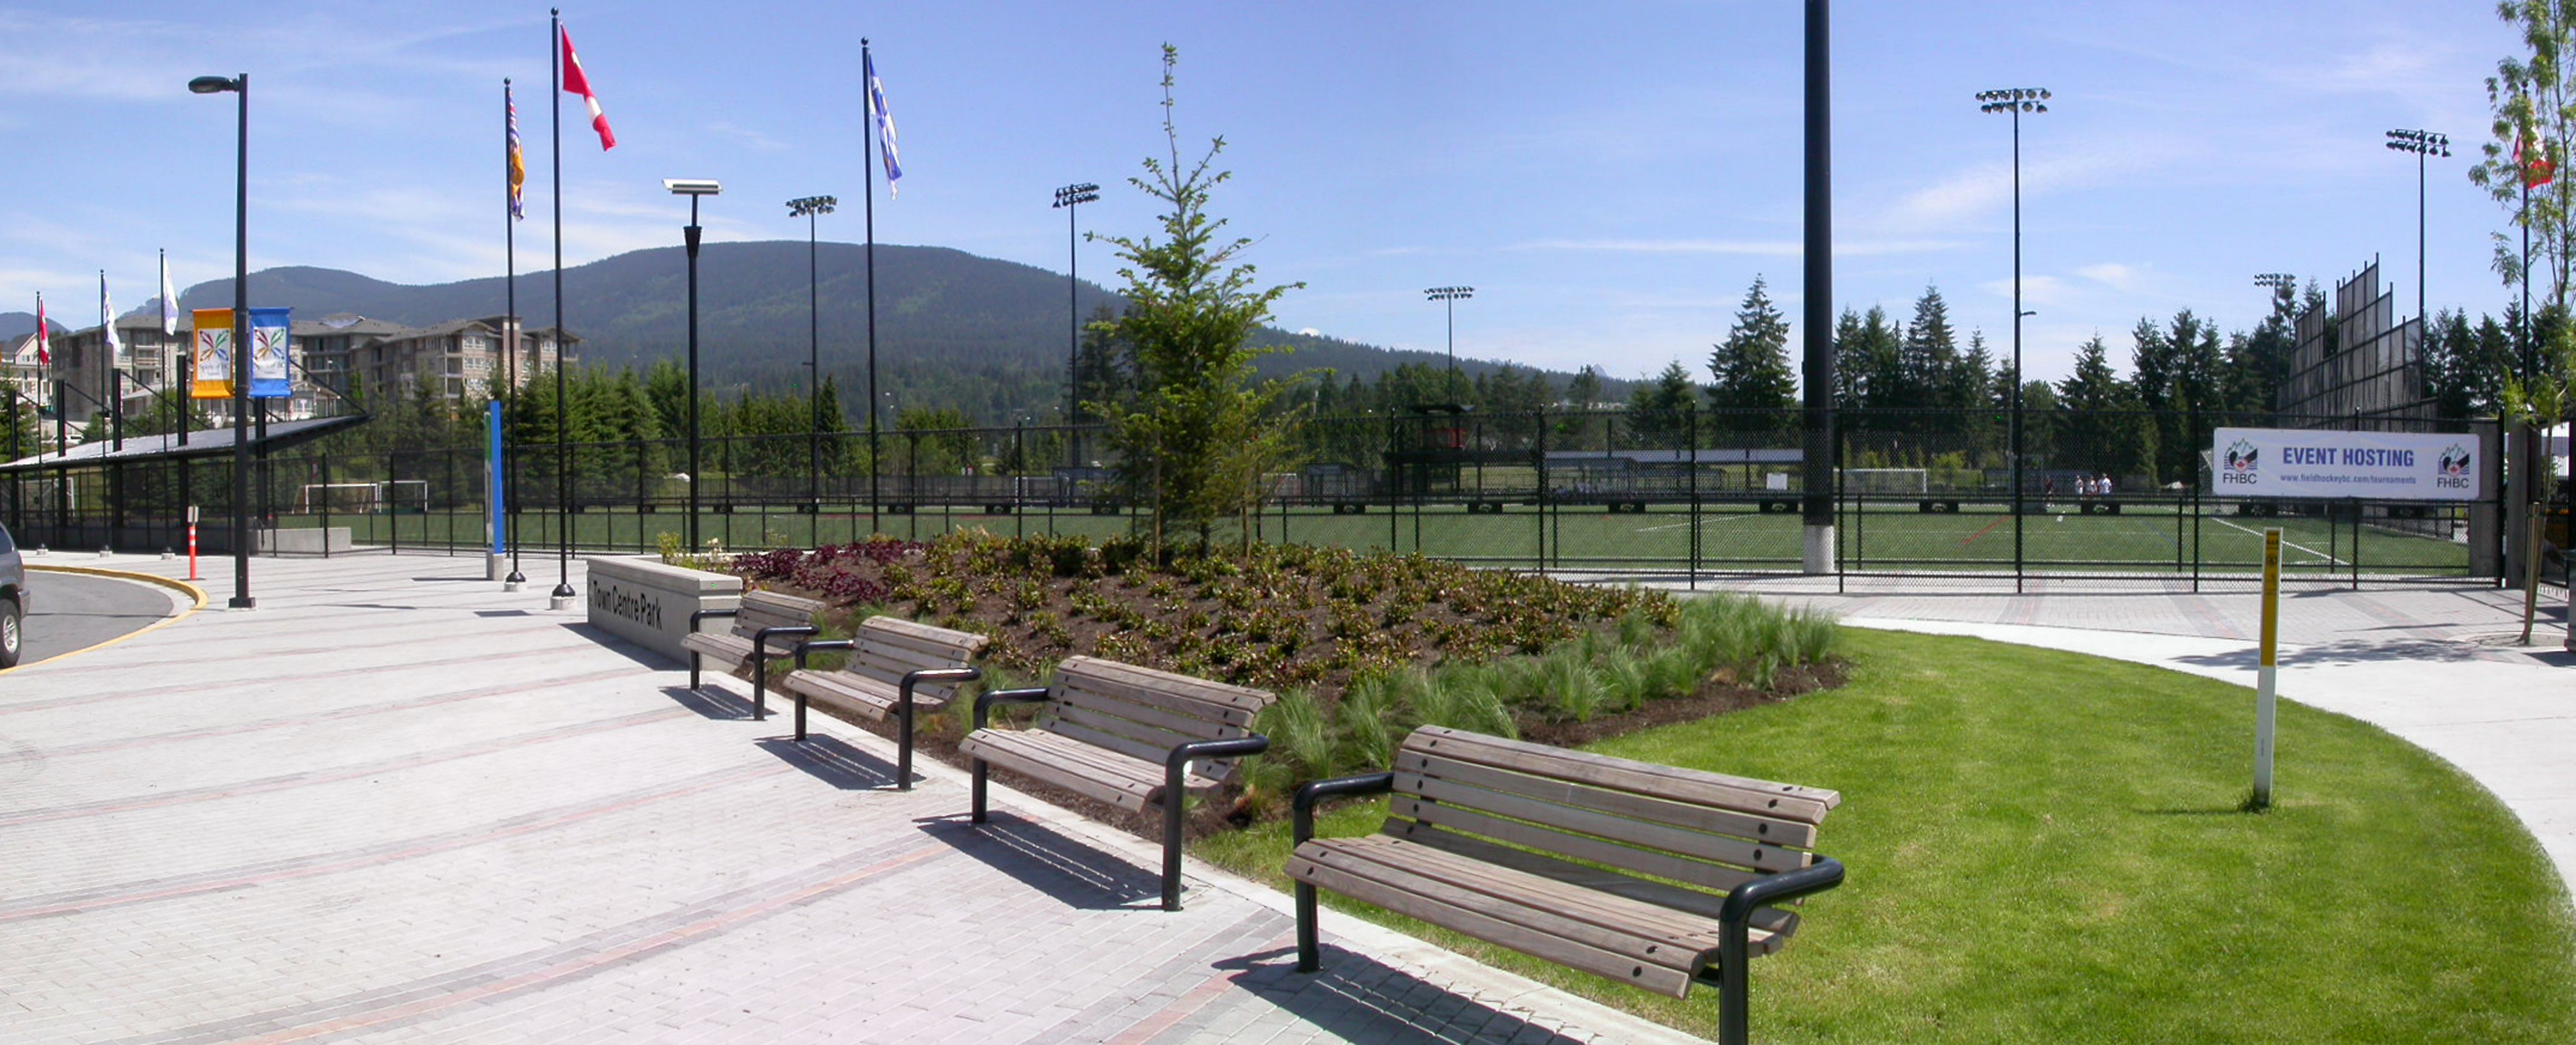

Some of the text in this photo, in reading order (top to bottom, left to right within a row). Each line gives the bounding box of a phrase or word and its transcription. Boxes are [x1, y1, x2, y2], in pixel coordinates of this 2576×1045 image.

[2283, 447, 2414, 467] EVENT HOSTING
[2223, 473, 2257, 484] FHBC
[2280, 474, 2416, 484] www.fieldhockeybc.com/tournaments
[2437, 477, 2469, 488] FHBC
[593, 580, 662, 630] Town Centre Park
